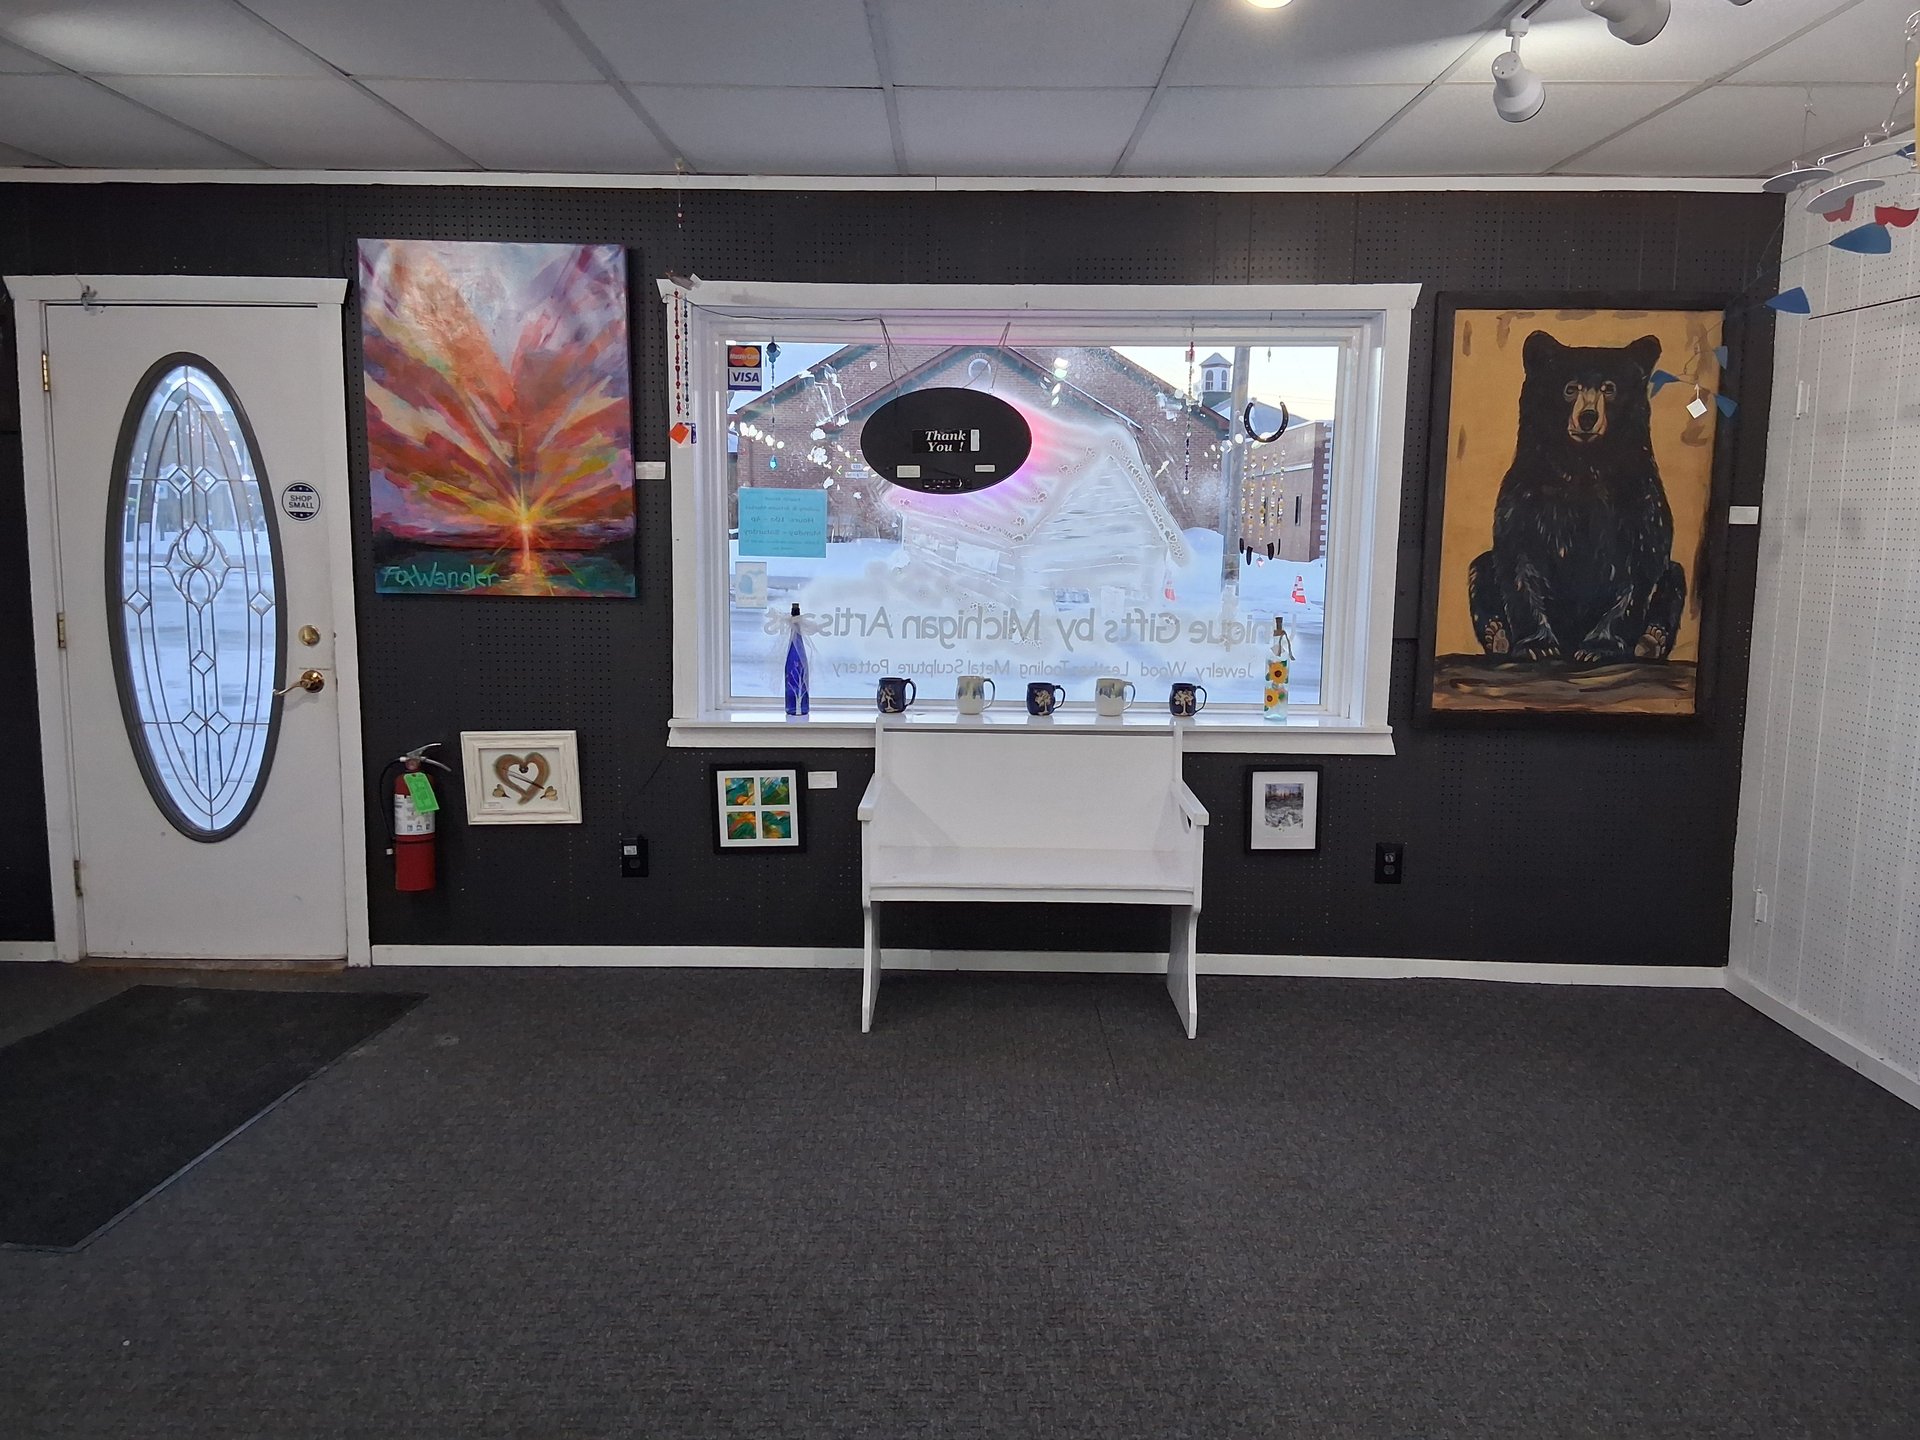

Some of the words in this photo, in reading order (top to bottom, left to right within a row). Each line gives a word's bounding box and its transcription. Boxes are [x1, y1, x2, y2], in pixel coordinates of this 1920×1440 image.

[732, 371, 760, 383] VISA
[925, 429, 967, 441] Thank
[927, 441, 953, 452] You
[959, 441, 964, 452] !
[290, 494, 313, 502] SHOP
[288, 501, 315, 509] SMALL
